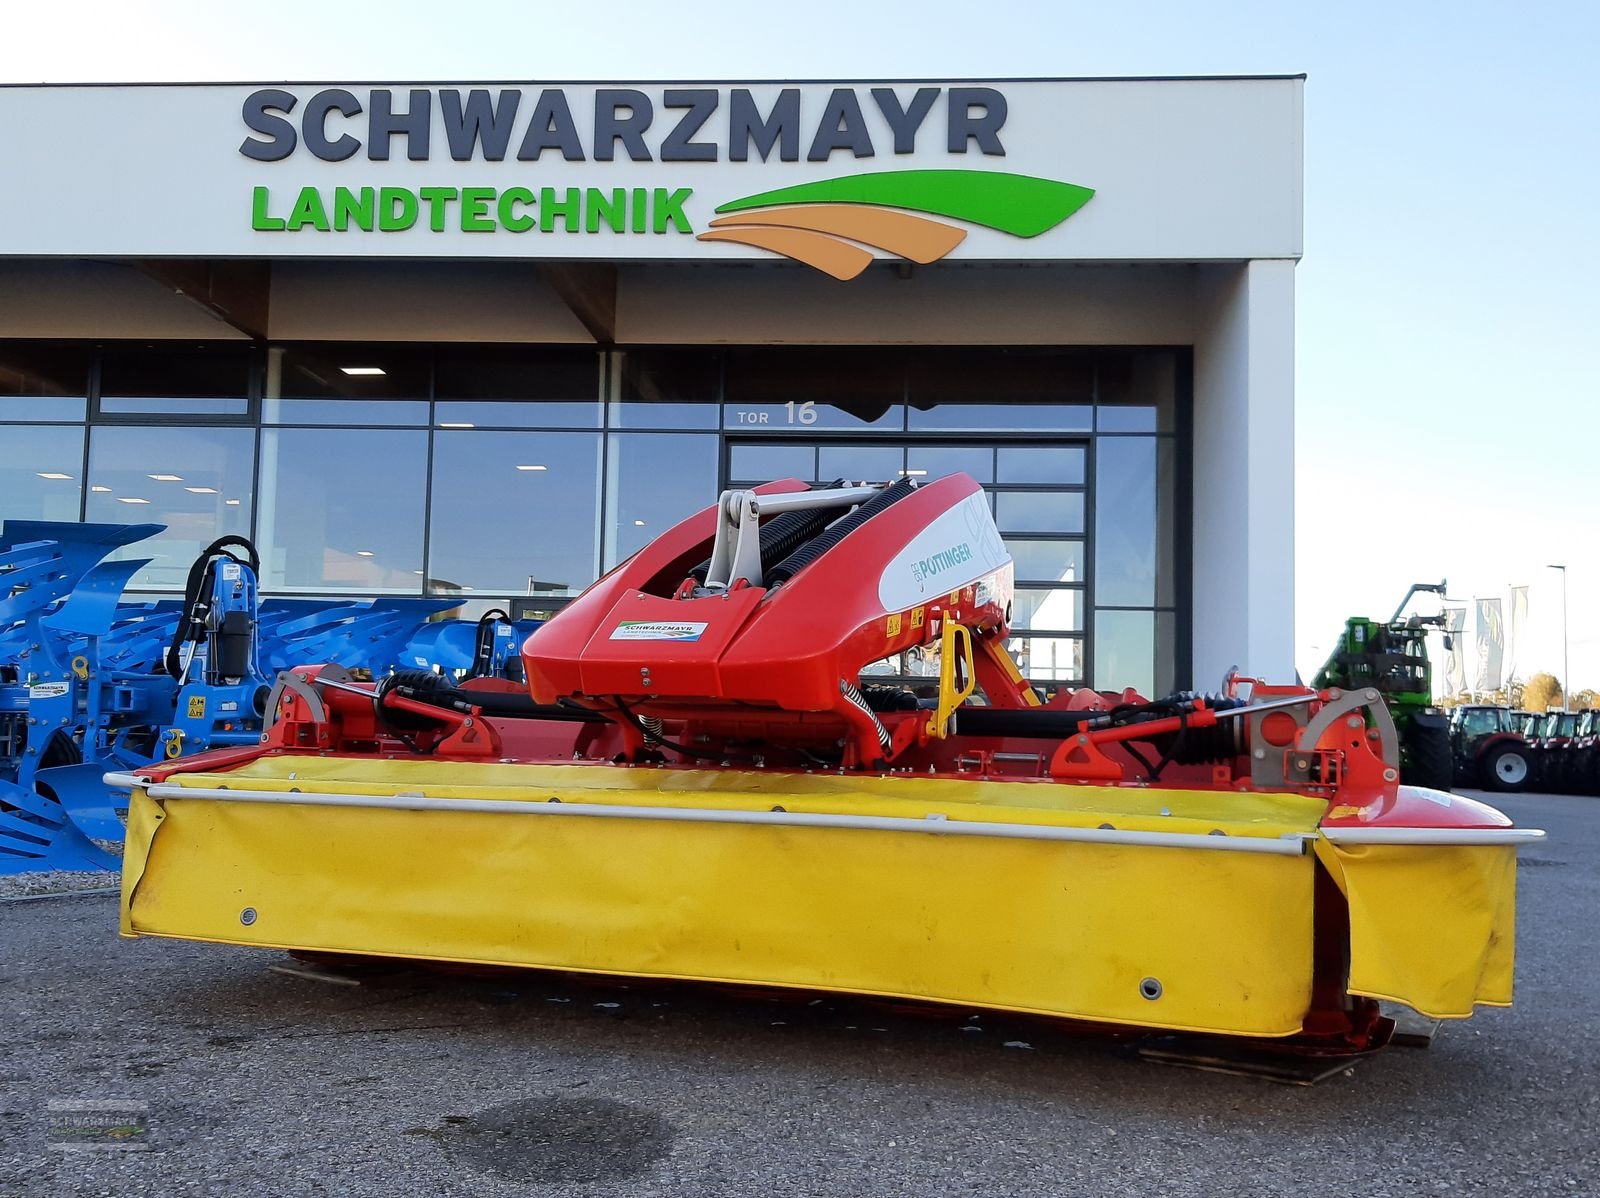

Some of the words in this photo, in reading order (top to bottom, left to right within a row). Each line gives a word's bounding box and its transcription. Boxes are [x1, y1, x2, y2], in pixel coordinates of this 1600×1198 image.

[240, 86, 1009, 162] SCHWARZMAYR
[253, 186, 695, 234] LANDTECHNIK
[737, 412, 769, 424] TOR
[784, 400, 818, 425] 16
